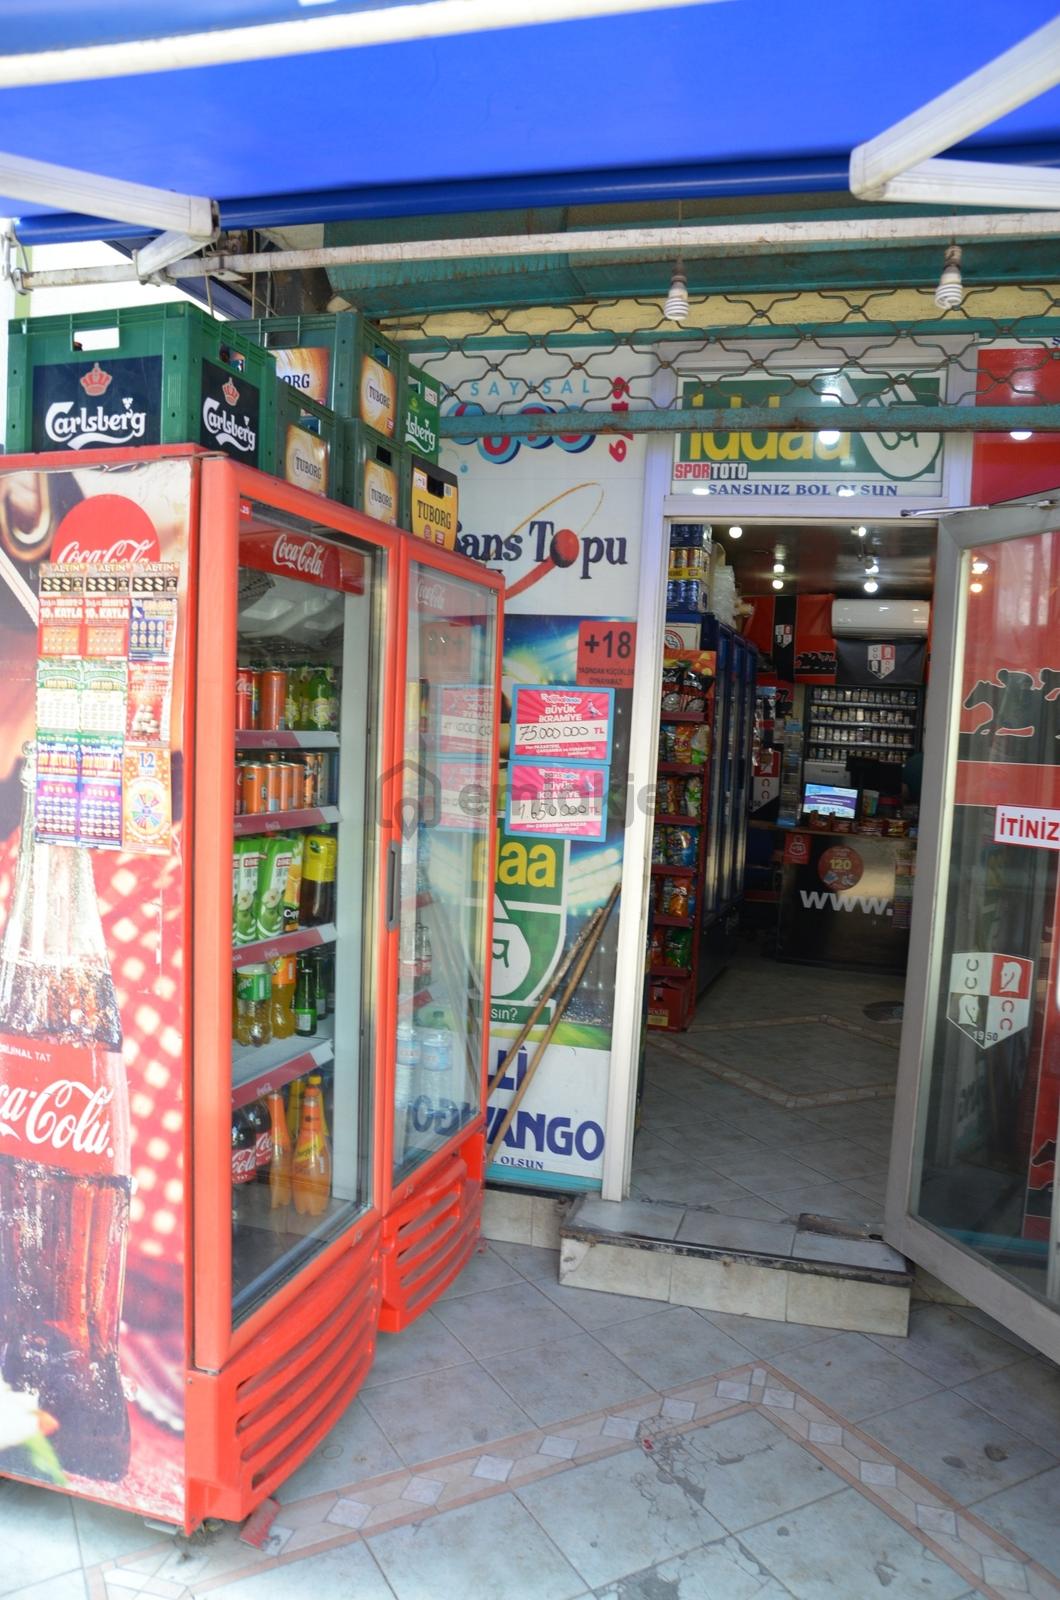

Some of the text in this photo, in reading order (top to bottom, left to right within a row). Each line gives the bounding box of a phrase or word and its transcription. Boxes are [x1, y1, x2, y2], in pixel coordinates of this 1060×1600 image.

[368, 385, 391, 409] TUBORG
[45, 400, 147, 444] Carlsberg
[202, 397, 256, 452] Carlsberg
[295, 456, 322, 480] TUBORG
[370, 488, 393, 506] TUBORG
[796, 484, 833, 496] BOL
[416, 500, 452, 530] TUBORG
[272, 533, 324, 576] Coca-Cola
[584, 630, 632, 658] +18
[545, 704, 577, 714] BÜYÜK
[594, 727, 605, 735] TL
[999, 812, 1060, 841] İTİNİZ
[830, 859, 852, 870] 120
[800, 890, 894, 916] www.
[500, 1155, 545, 1171] OLSUN
